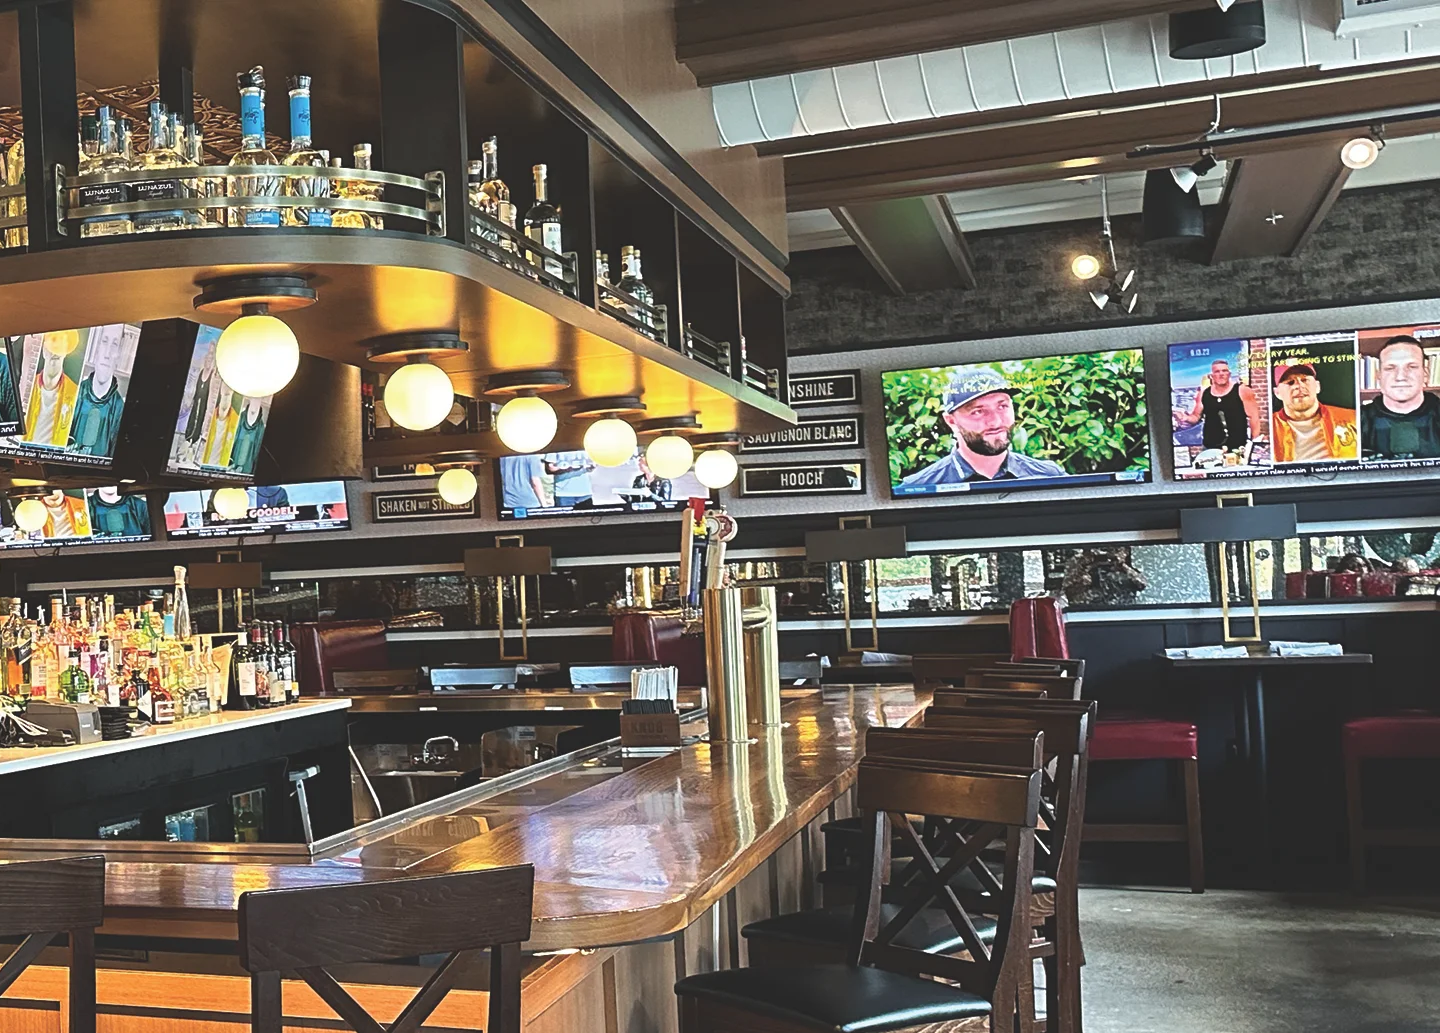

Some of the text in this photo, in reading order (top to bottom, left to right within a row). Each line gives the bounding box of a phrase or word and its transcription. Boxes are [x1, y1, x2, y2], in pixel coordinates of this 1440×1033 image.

[85, 187, 120, 196] LUNAZUL
[138, 183, 174, 192] LUNAZUL
[814, 425, 852, 440] BLANC
[780, 472, 823, 486] HOOCH
[249, 505, 300, 519] GOODELL
[380, 500, 416, 513] SHAKEN
